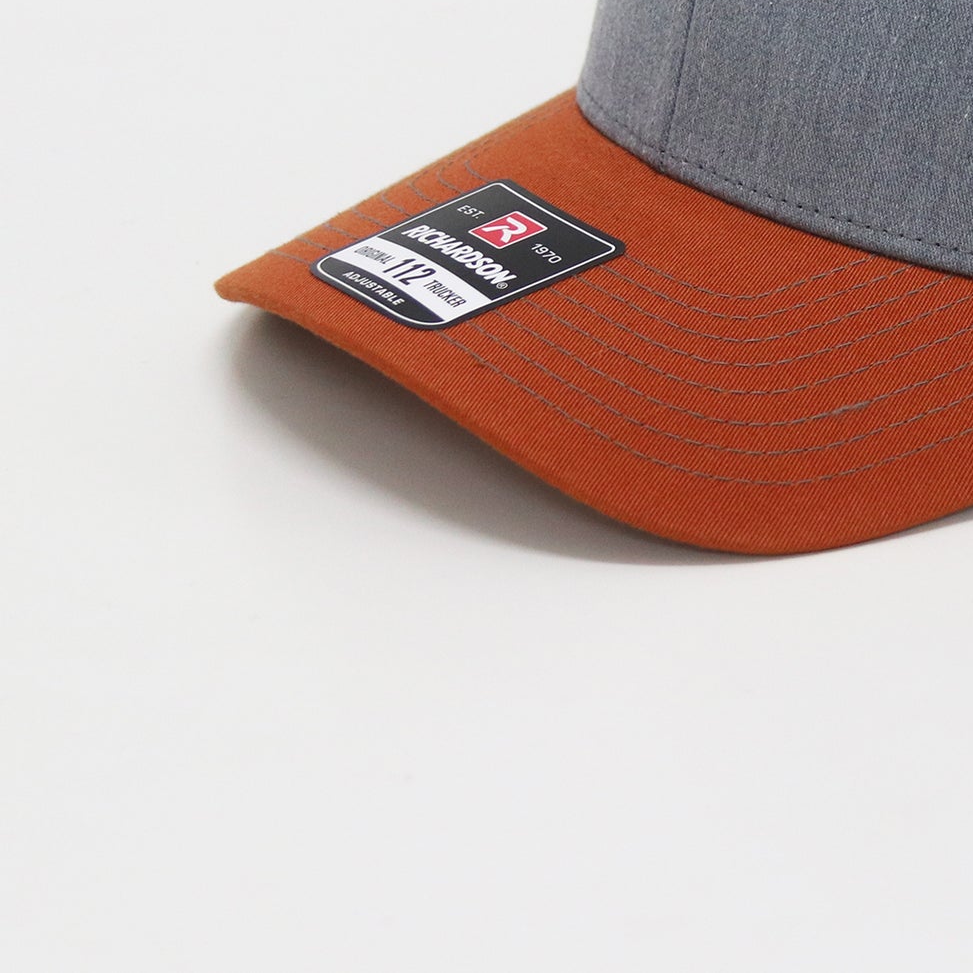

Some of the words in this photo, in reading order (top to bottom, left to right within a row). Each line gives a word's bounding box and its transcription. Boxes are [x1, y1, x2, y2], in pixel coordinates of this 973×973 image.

[457, 204, 485, 219] EST.
[530, 242, 563, 264] 1970
[342, 270, 405, 307] ADJUSTABLE
[354, 245, 396, 265] ORIGINAL
[382, 257, 436, 286] 112
[422, 279, 467, 308] TRUCKER
